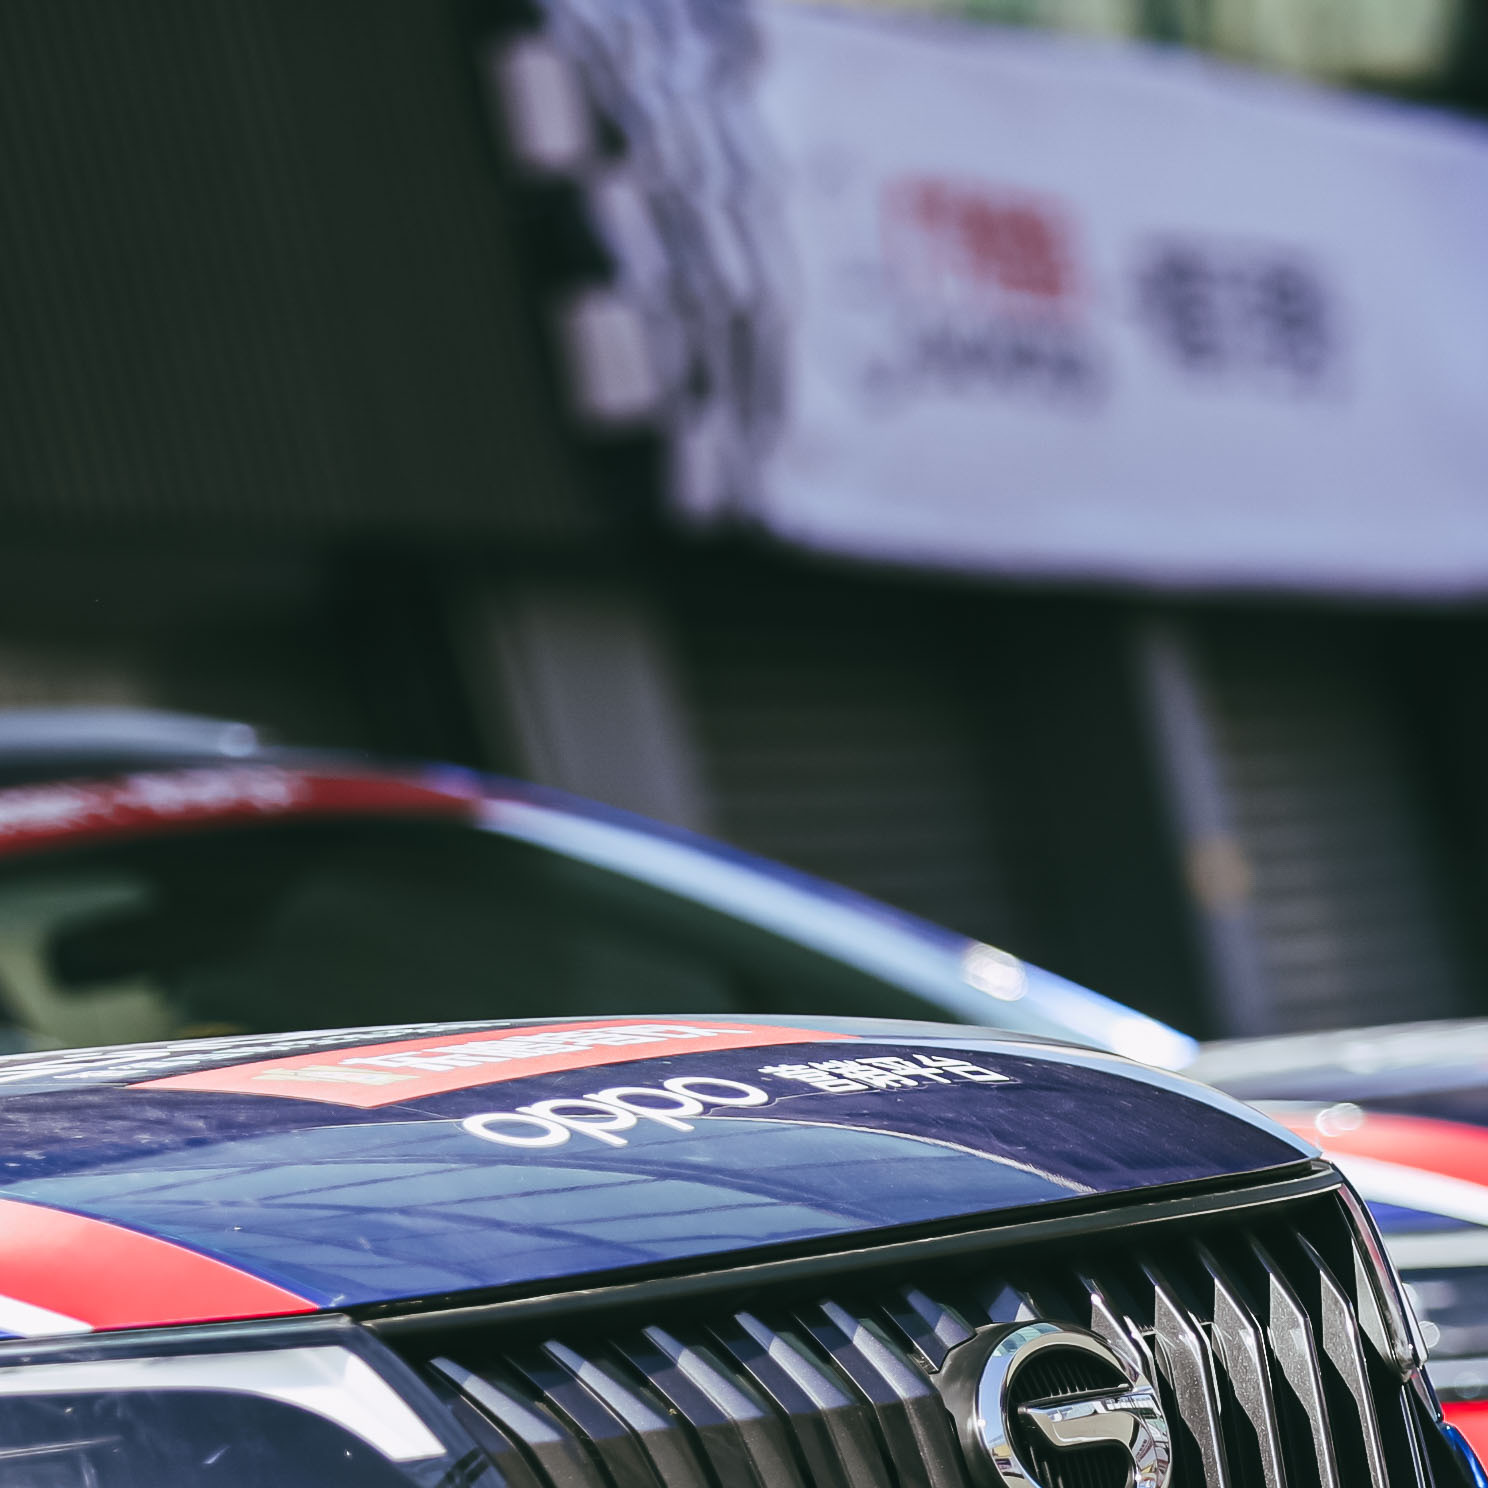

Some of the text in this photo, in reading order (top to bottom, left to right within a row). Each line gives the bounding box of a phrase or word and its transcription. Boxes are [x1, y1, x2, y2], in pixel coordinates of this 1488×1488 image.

[757, 1053, 1012, 1094] 营销平台
[460, 1076, 770, 1148] oppo
